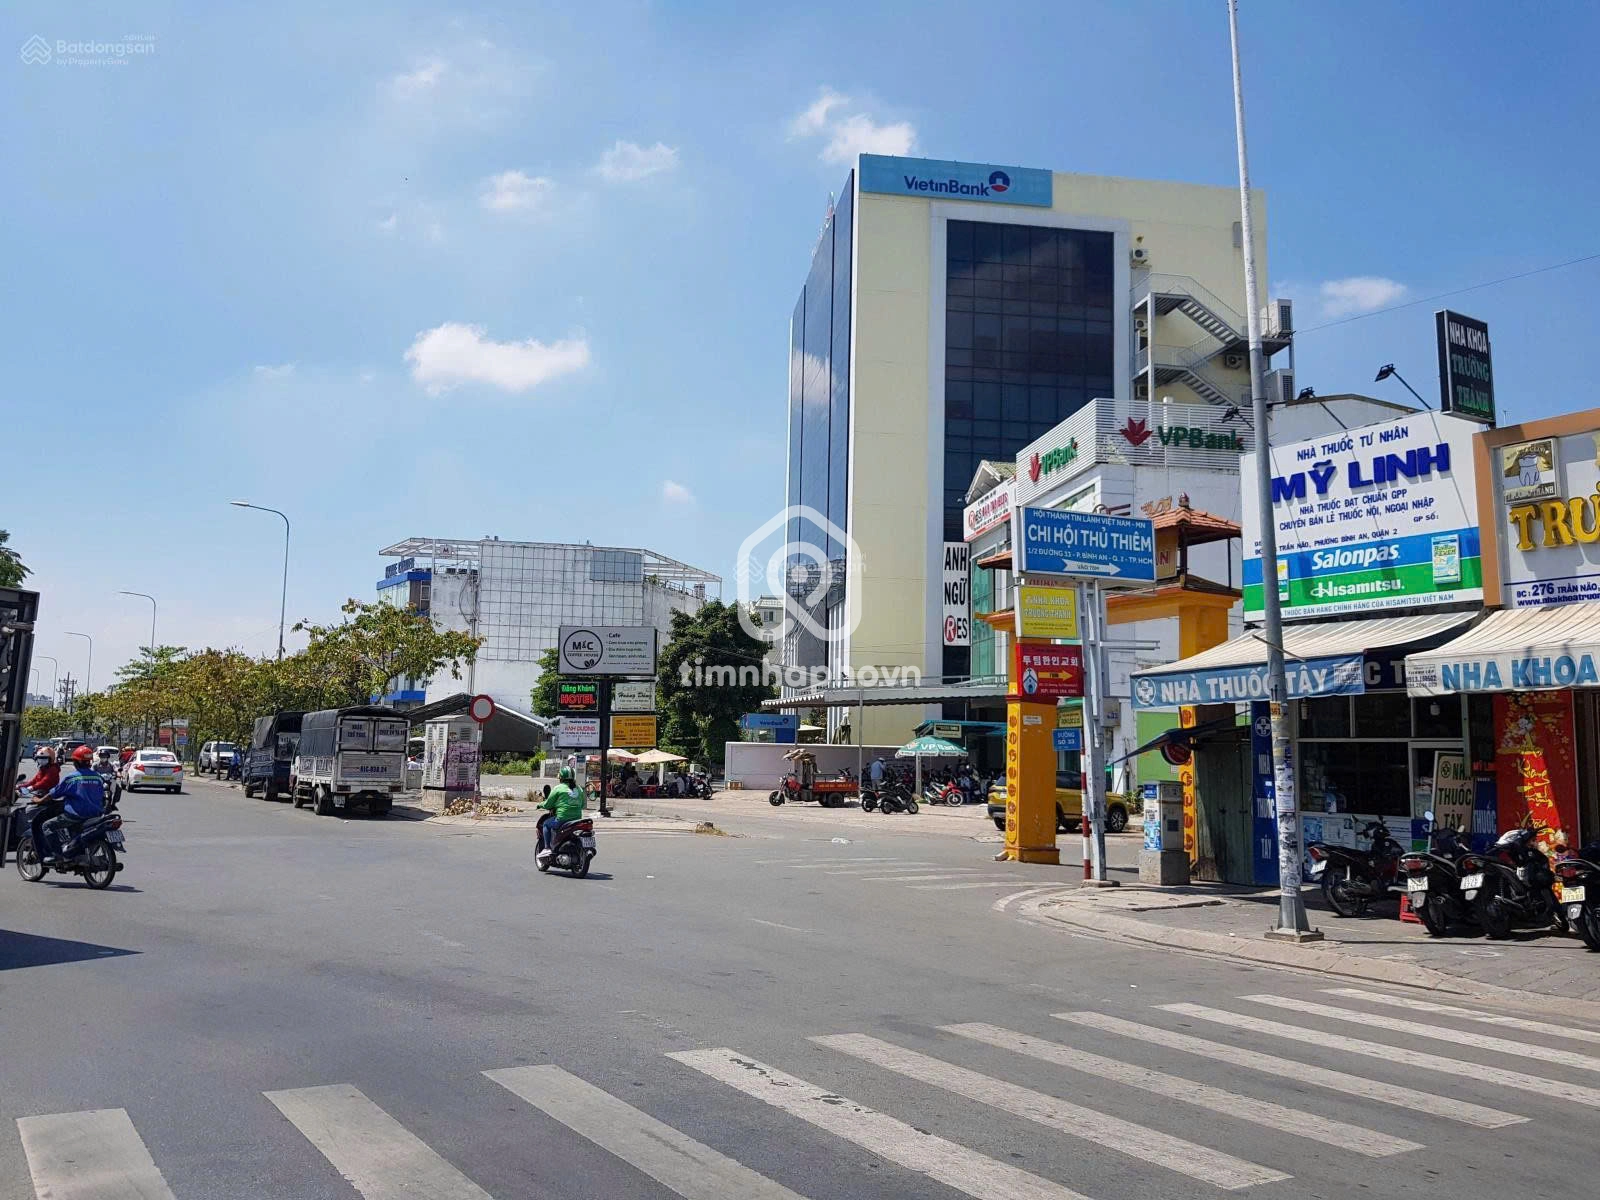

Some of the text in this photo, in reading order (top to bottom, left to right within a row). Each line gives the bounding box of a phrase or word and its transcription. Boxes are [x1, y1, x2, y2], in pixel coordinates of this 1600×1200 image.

[903, 175, 990, 197] VietinBank
[1449, 321, 1488, 354] NHA KHOA
[1157, 425, 1245, 451] VPBank
[1297, 425, 1409, 462] NHÀ THUỐC TƯ NHÂN
[1041, 436, 1078, 475] VPBank
[1271, 443, 1450, 504] MỸ LINH
[1279, 496, 1435, 531] CHUYÊN BÁN LẺ THUỐC NỘI, NGOẠI NHẬP
[1299, 488, 1408, 515] NHÀ THUỐC ĐẠT CHUẨN GPP
[1071, 513, 1081, 521] TIN
[1116, 519, 1131, 528] NAM
[1135, 521, 1146, 529] MN
[1413, 515, 1423, 523] GP
[1028, 523, 1152, 552] CHI HỘI THỦ THIÊM
[1371, 528, 1390, 540] QUẬN
[943, 546, 967, 572] ANH
[1311, 543, 1400, 571] Salonpas
[943, 577, 968, 606] NGỮ
[1385, 595, 1421, 607] HISAMITSU
[1423, 593, 1437, 604] VIỆT
[1438, 593, 1454, 601] NAM
[1531, 582, 1555, 597] 276
[944, 614, 968, 643] RES
[1160, 673, 1202, 703] NHÀ
[1285, 664, 1328, 694] TÂY
[1441, 652, 1600, 691] NHA KHOA
[560, 694, 596, 705] HOTEL
[1438, 782, 1472, 806] THUỐC
